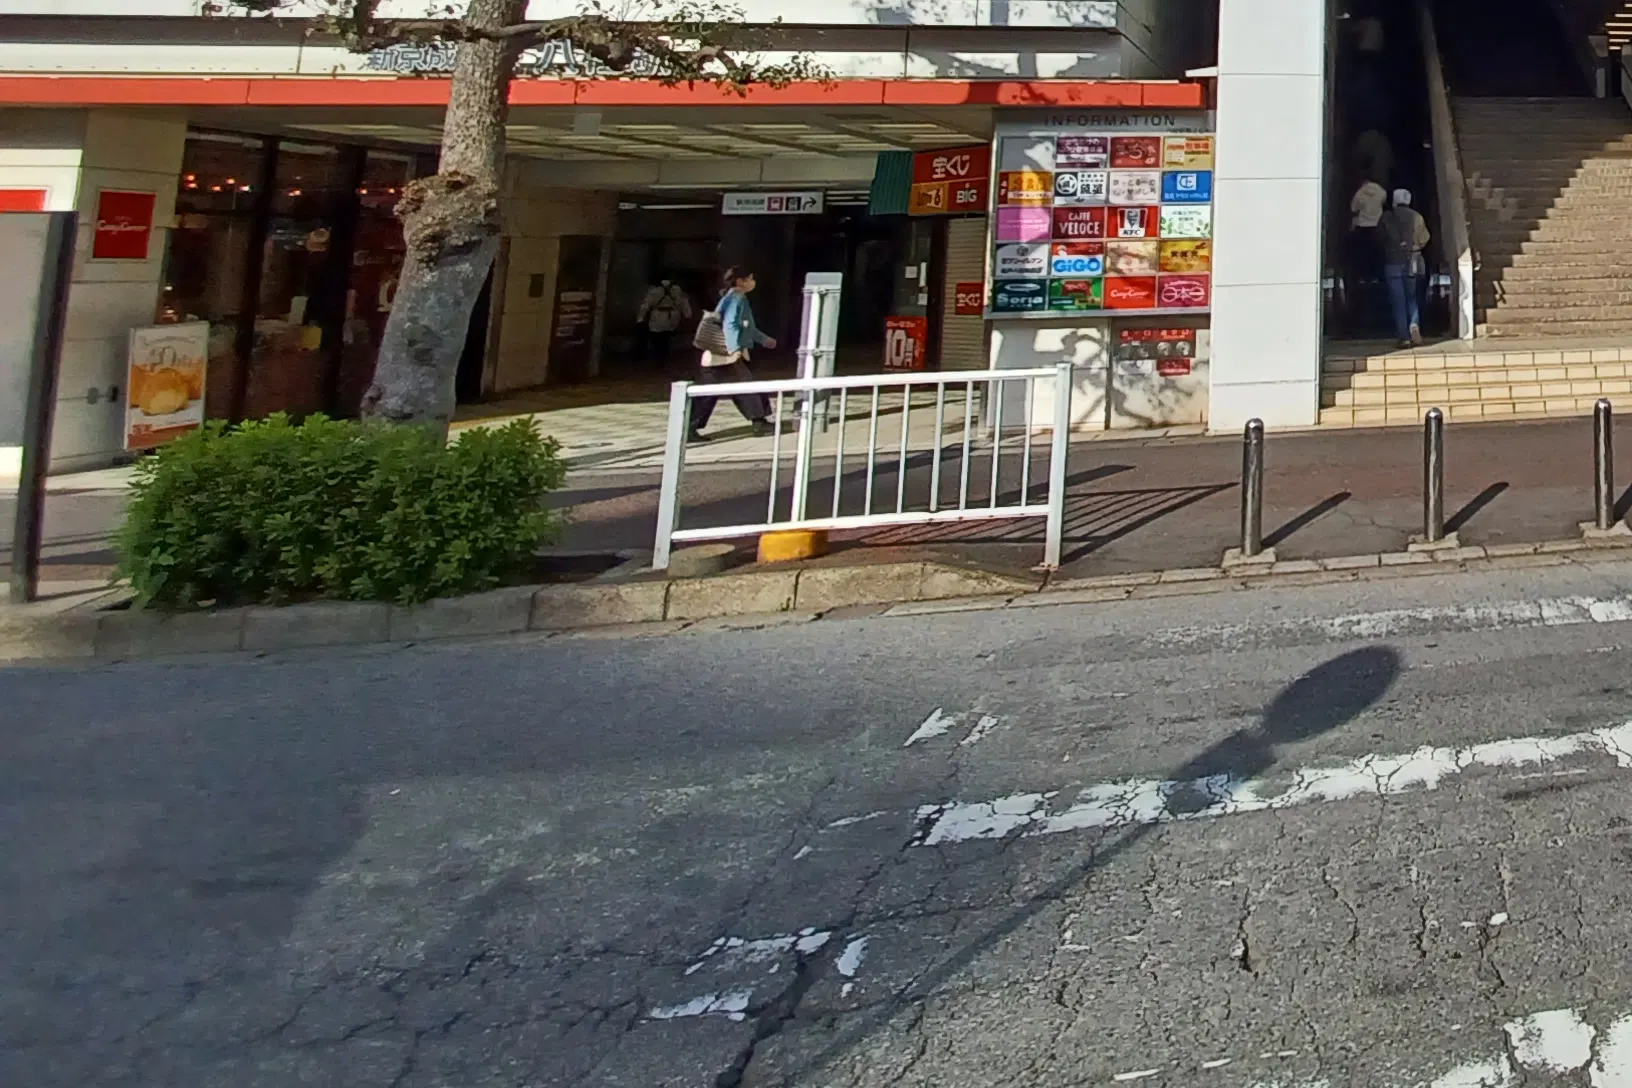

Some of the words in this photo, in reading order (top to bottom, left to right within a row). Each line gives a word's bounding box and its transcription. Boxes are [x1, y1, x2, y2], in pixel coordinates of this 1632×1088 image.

[1044, 114, 1176, 127] INFORMATION
[932, 155, 970, 179] 宝くじ
[1059, 222, 1100, 235] VELOCE
